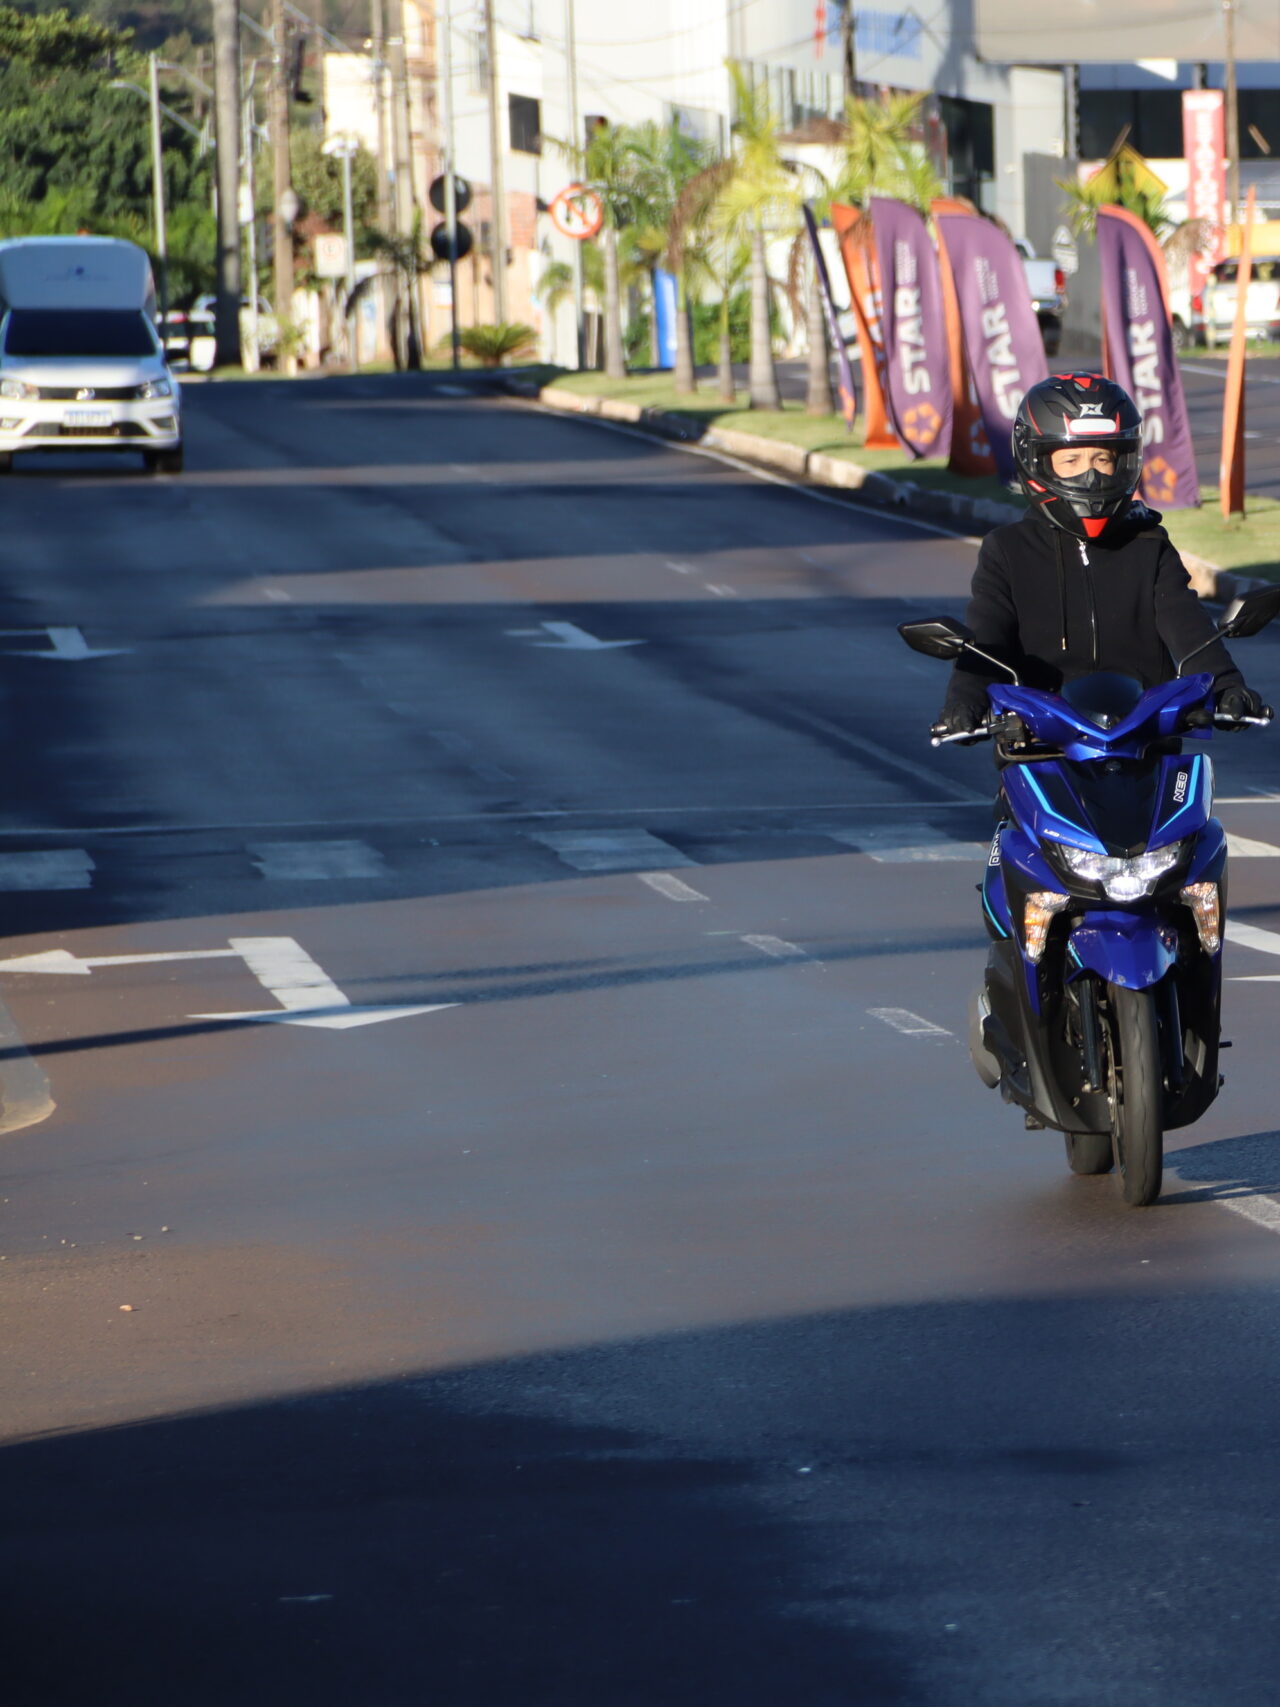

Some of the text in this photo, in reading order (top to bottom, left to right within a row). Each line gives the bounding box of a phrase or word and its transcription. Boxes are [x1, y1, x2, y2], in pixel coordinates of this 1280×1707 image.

[895, 286, 931, 395] STAR
[982, 302, 1025, 419] STAR
[1129, 319, 1164, 447] STAR
[1173, 771, 1188, 803] NEO
